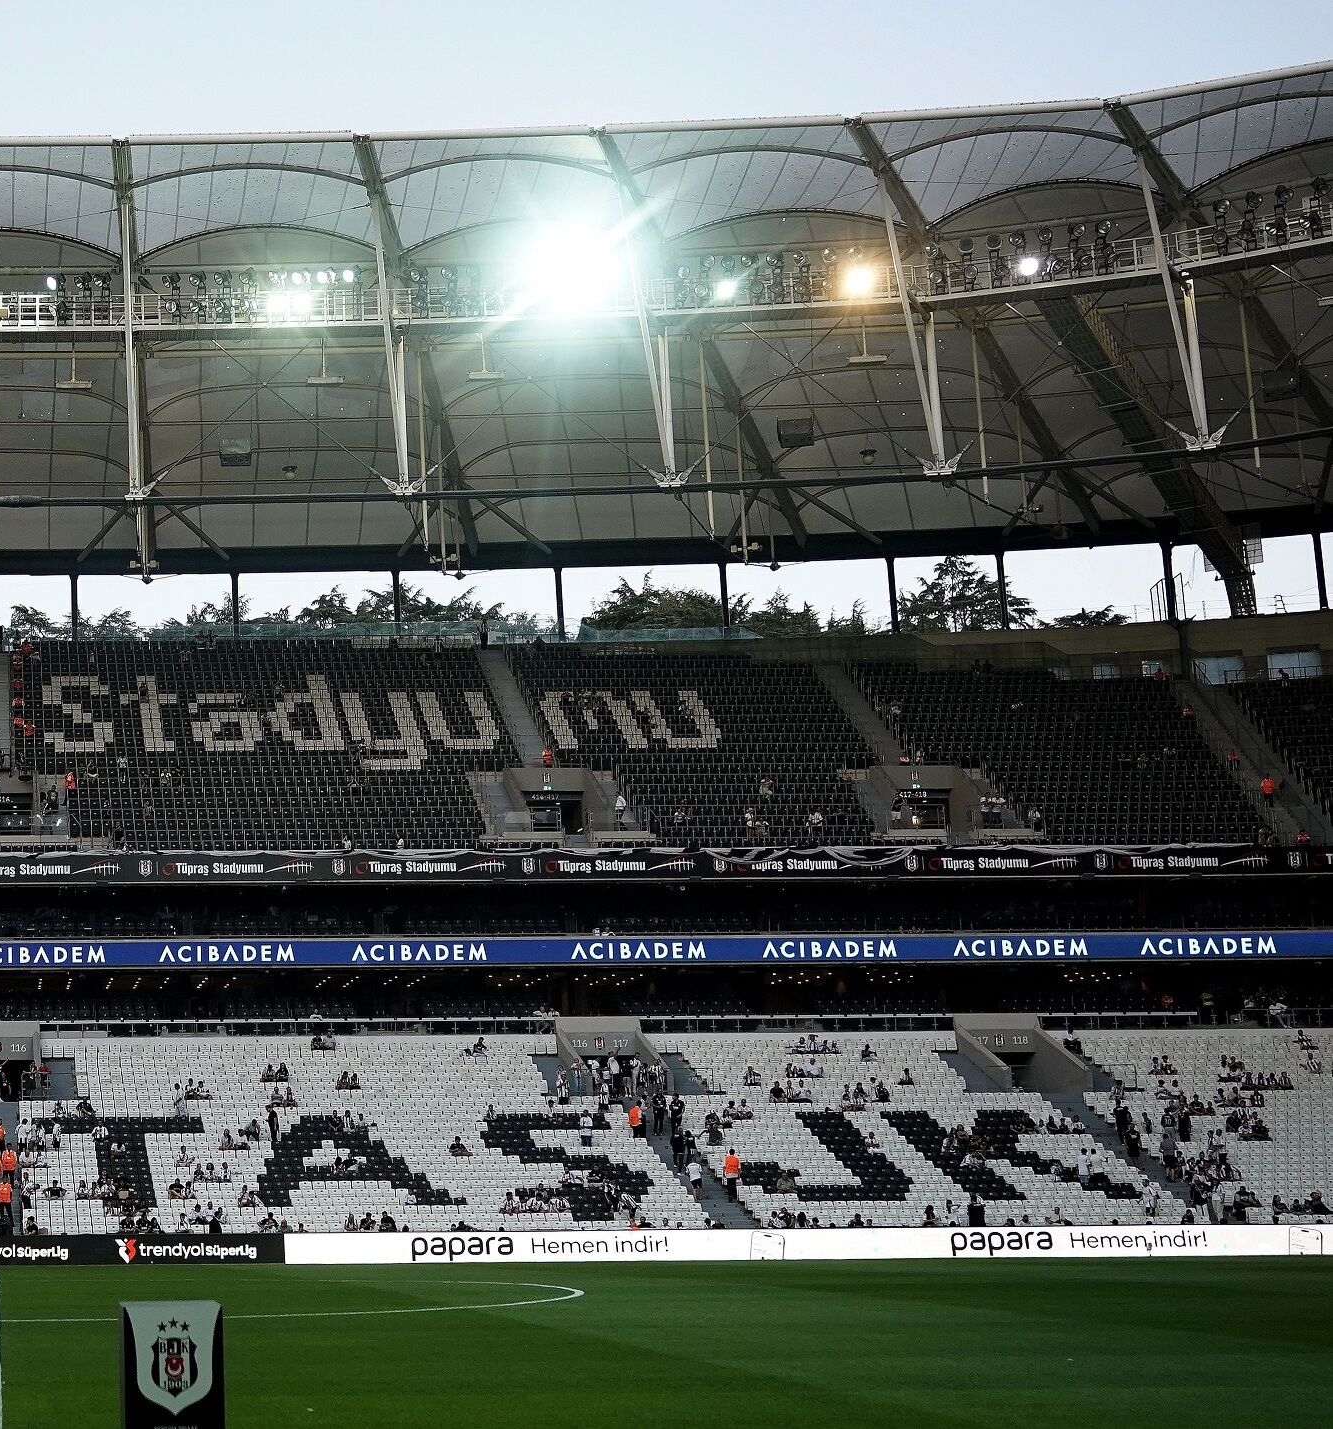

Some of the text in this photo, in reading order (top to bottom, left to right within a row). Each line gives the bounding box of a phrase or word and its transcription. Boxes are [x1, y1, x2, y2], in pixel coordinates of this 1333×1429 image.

[20, 863, 70, 876] Stadyumu
[176, 862, 263, 876] Tüpraş Stadyumu
[369, 861, 456, 874] Tüpraş Stadyumu
[558, 860, 646, 873] Tüpraş Stadyumu
[787, 859, 837, 870] Stadyumu
[941, 857, 1028, 870] Tüpraş Stadyumu
[1131, 856, 1218, 869] Tüpraş Stadyumu
[352, 943, 486, 961] ACIBADEM
[571, 942, 705, 959] ACIBADEM
[763, 940, 897, 958] ACIBADEM
[954, 939, 1087, 956] ACIBADEM
[1141, 937, 1276, 954] ACIBADEM
[160, 945, 294, 962] ACIBADEM
[572, 1040, 629, 1048] 116 117
[1012, 1036, 1028, 1045] 118
[11, 1044, 27, 1052] 116
[411, 1236, 668, 1261] papara Hemen indir!
[951, 1230, 1207, 1256] papara Hemen indir!
[139, 1243, 205, 1259] trendyol
